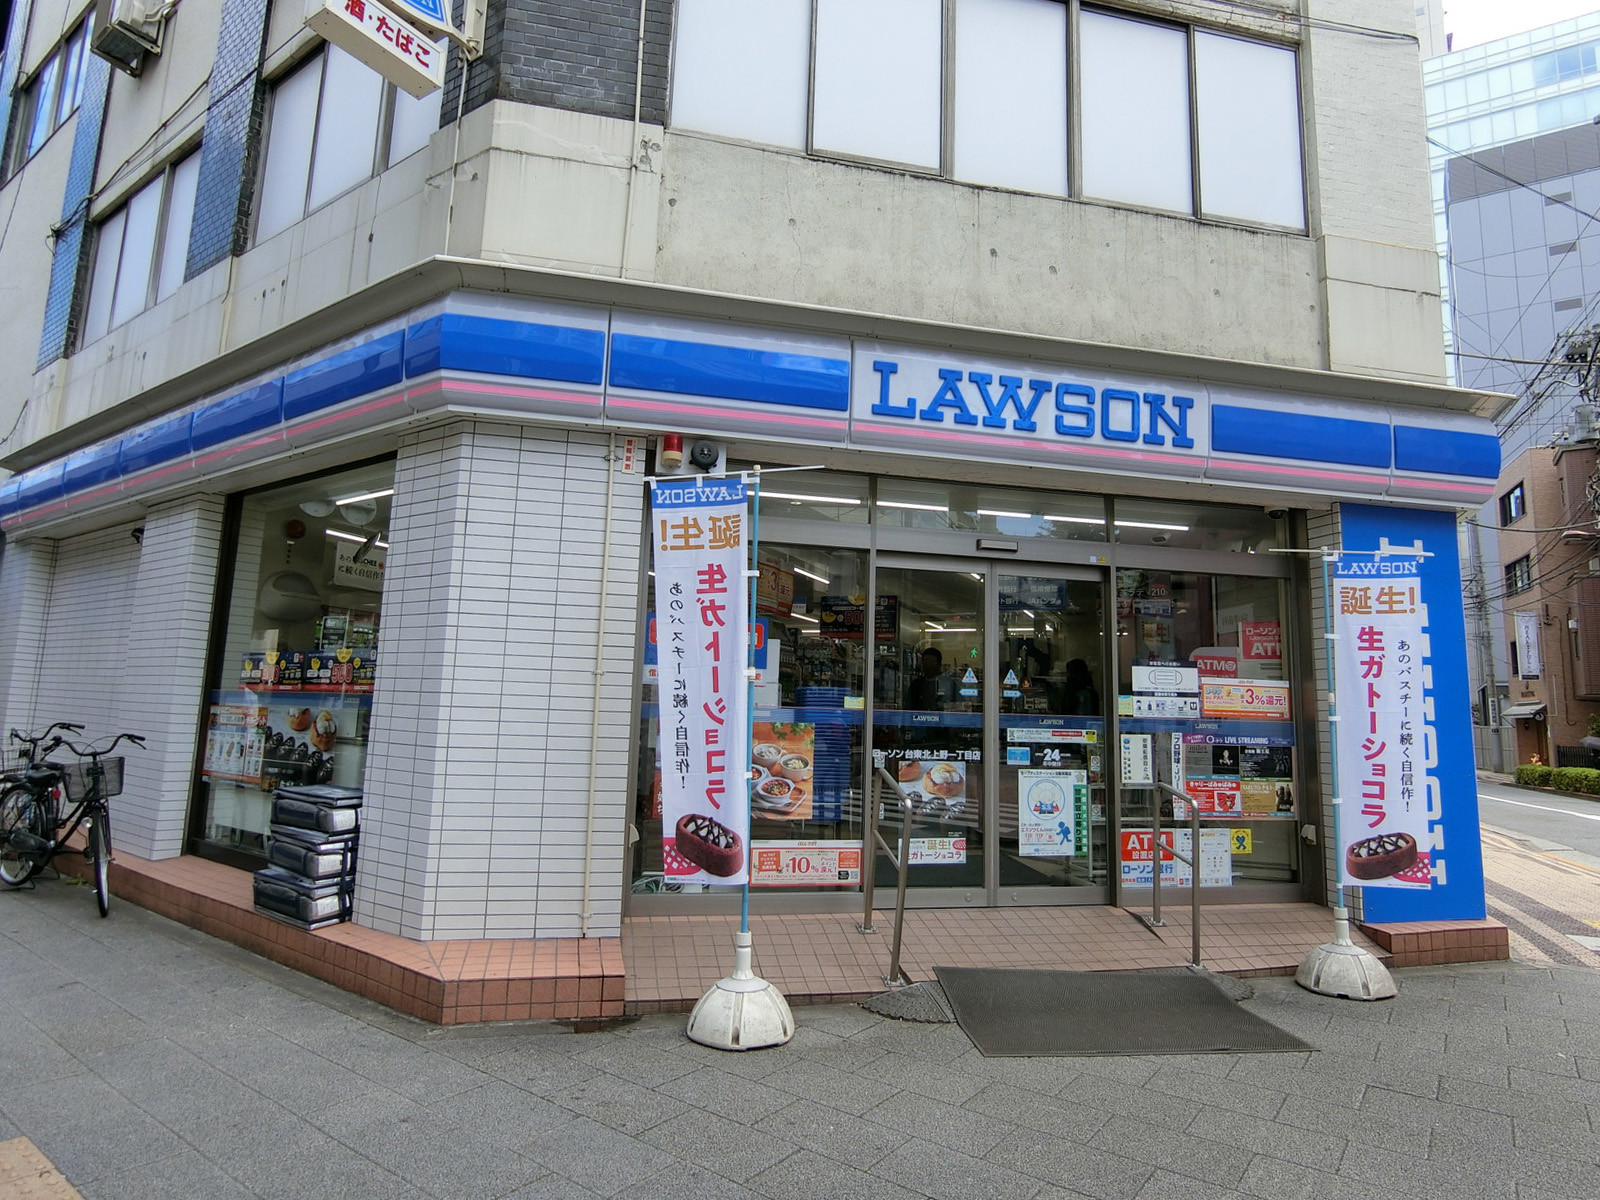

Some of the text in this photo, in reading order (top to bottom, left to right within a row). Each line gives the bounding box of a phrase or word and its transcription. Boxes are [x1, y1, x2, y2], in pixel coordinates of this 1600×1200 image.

[345, 0, 430, 68] 酒・たばこ
[872, 360, 1195, 449] LAWSON
[1337, 561, 1418, 575] LAWSON
[1339, 586, 1416, 615] 誕生!
[1197, 659, 1226, 671] ATM
[1224, 736, 1236, 744] LIVE
[1237, 736, 1269, 745] STREAMING
[1357, 625, 1387, 829] 生ガトーショコラ
[1397, 639, 1415, 813] あのバスチーに続く自信作!
[1043, 748, 1061, 761] 24
